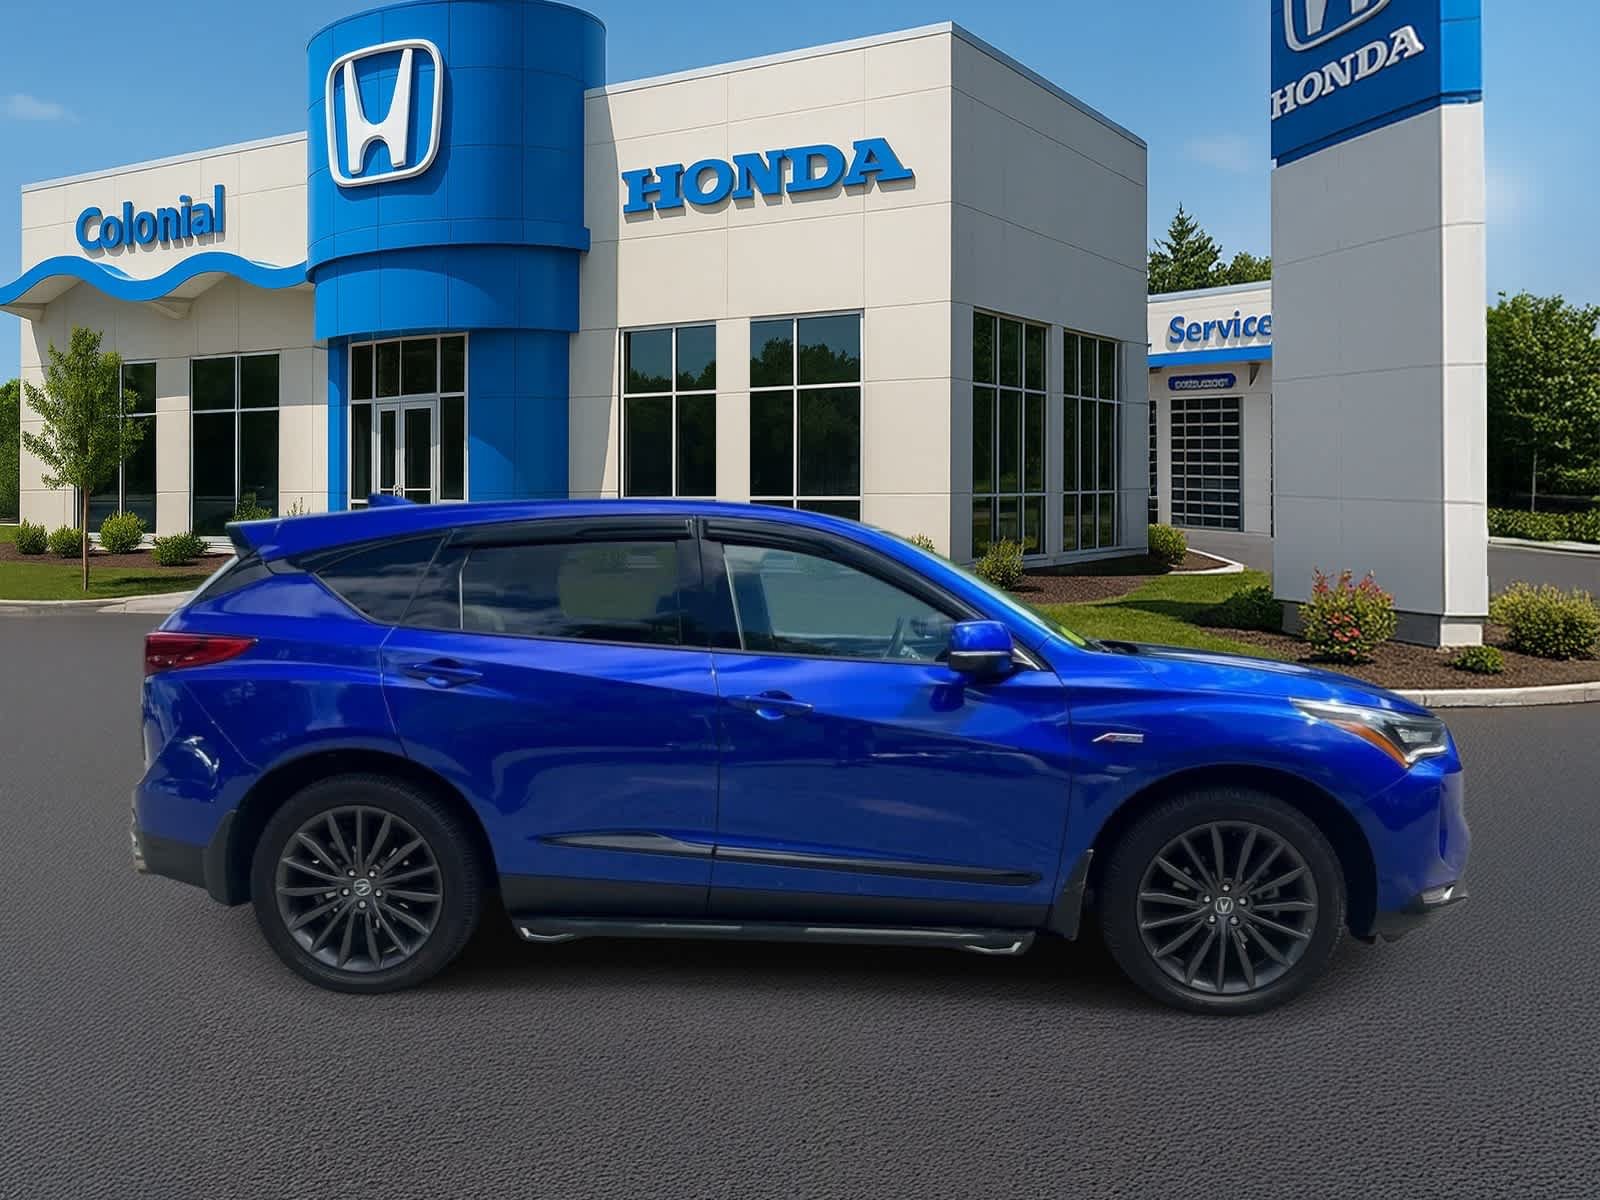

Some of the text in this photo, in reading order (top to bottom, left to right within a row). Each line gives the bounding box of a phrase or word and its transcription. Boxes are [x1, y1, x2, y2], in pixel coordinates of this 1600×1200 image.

[1271, 25, 1425, 120] HONDA
[621, 137, 914, 214] HONDA
[76, 184, 225, 251] Colonial
[1169, 309, 1272, 344] Service
